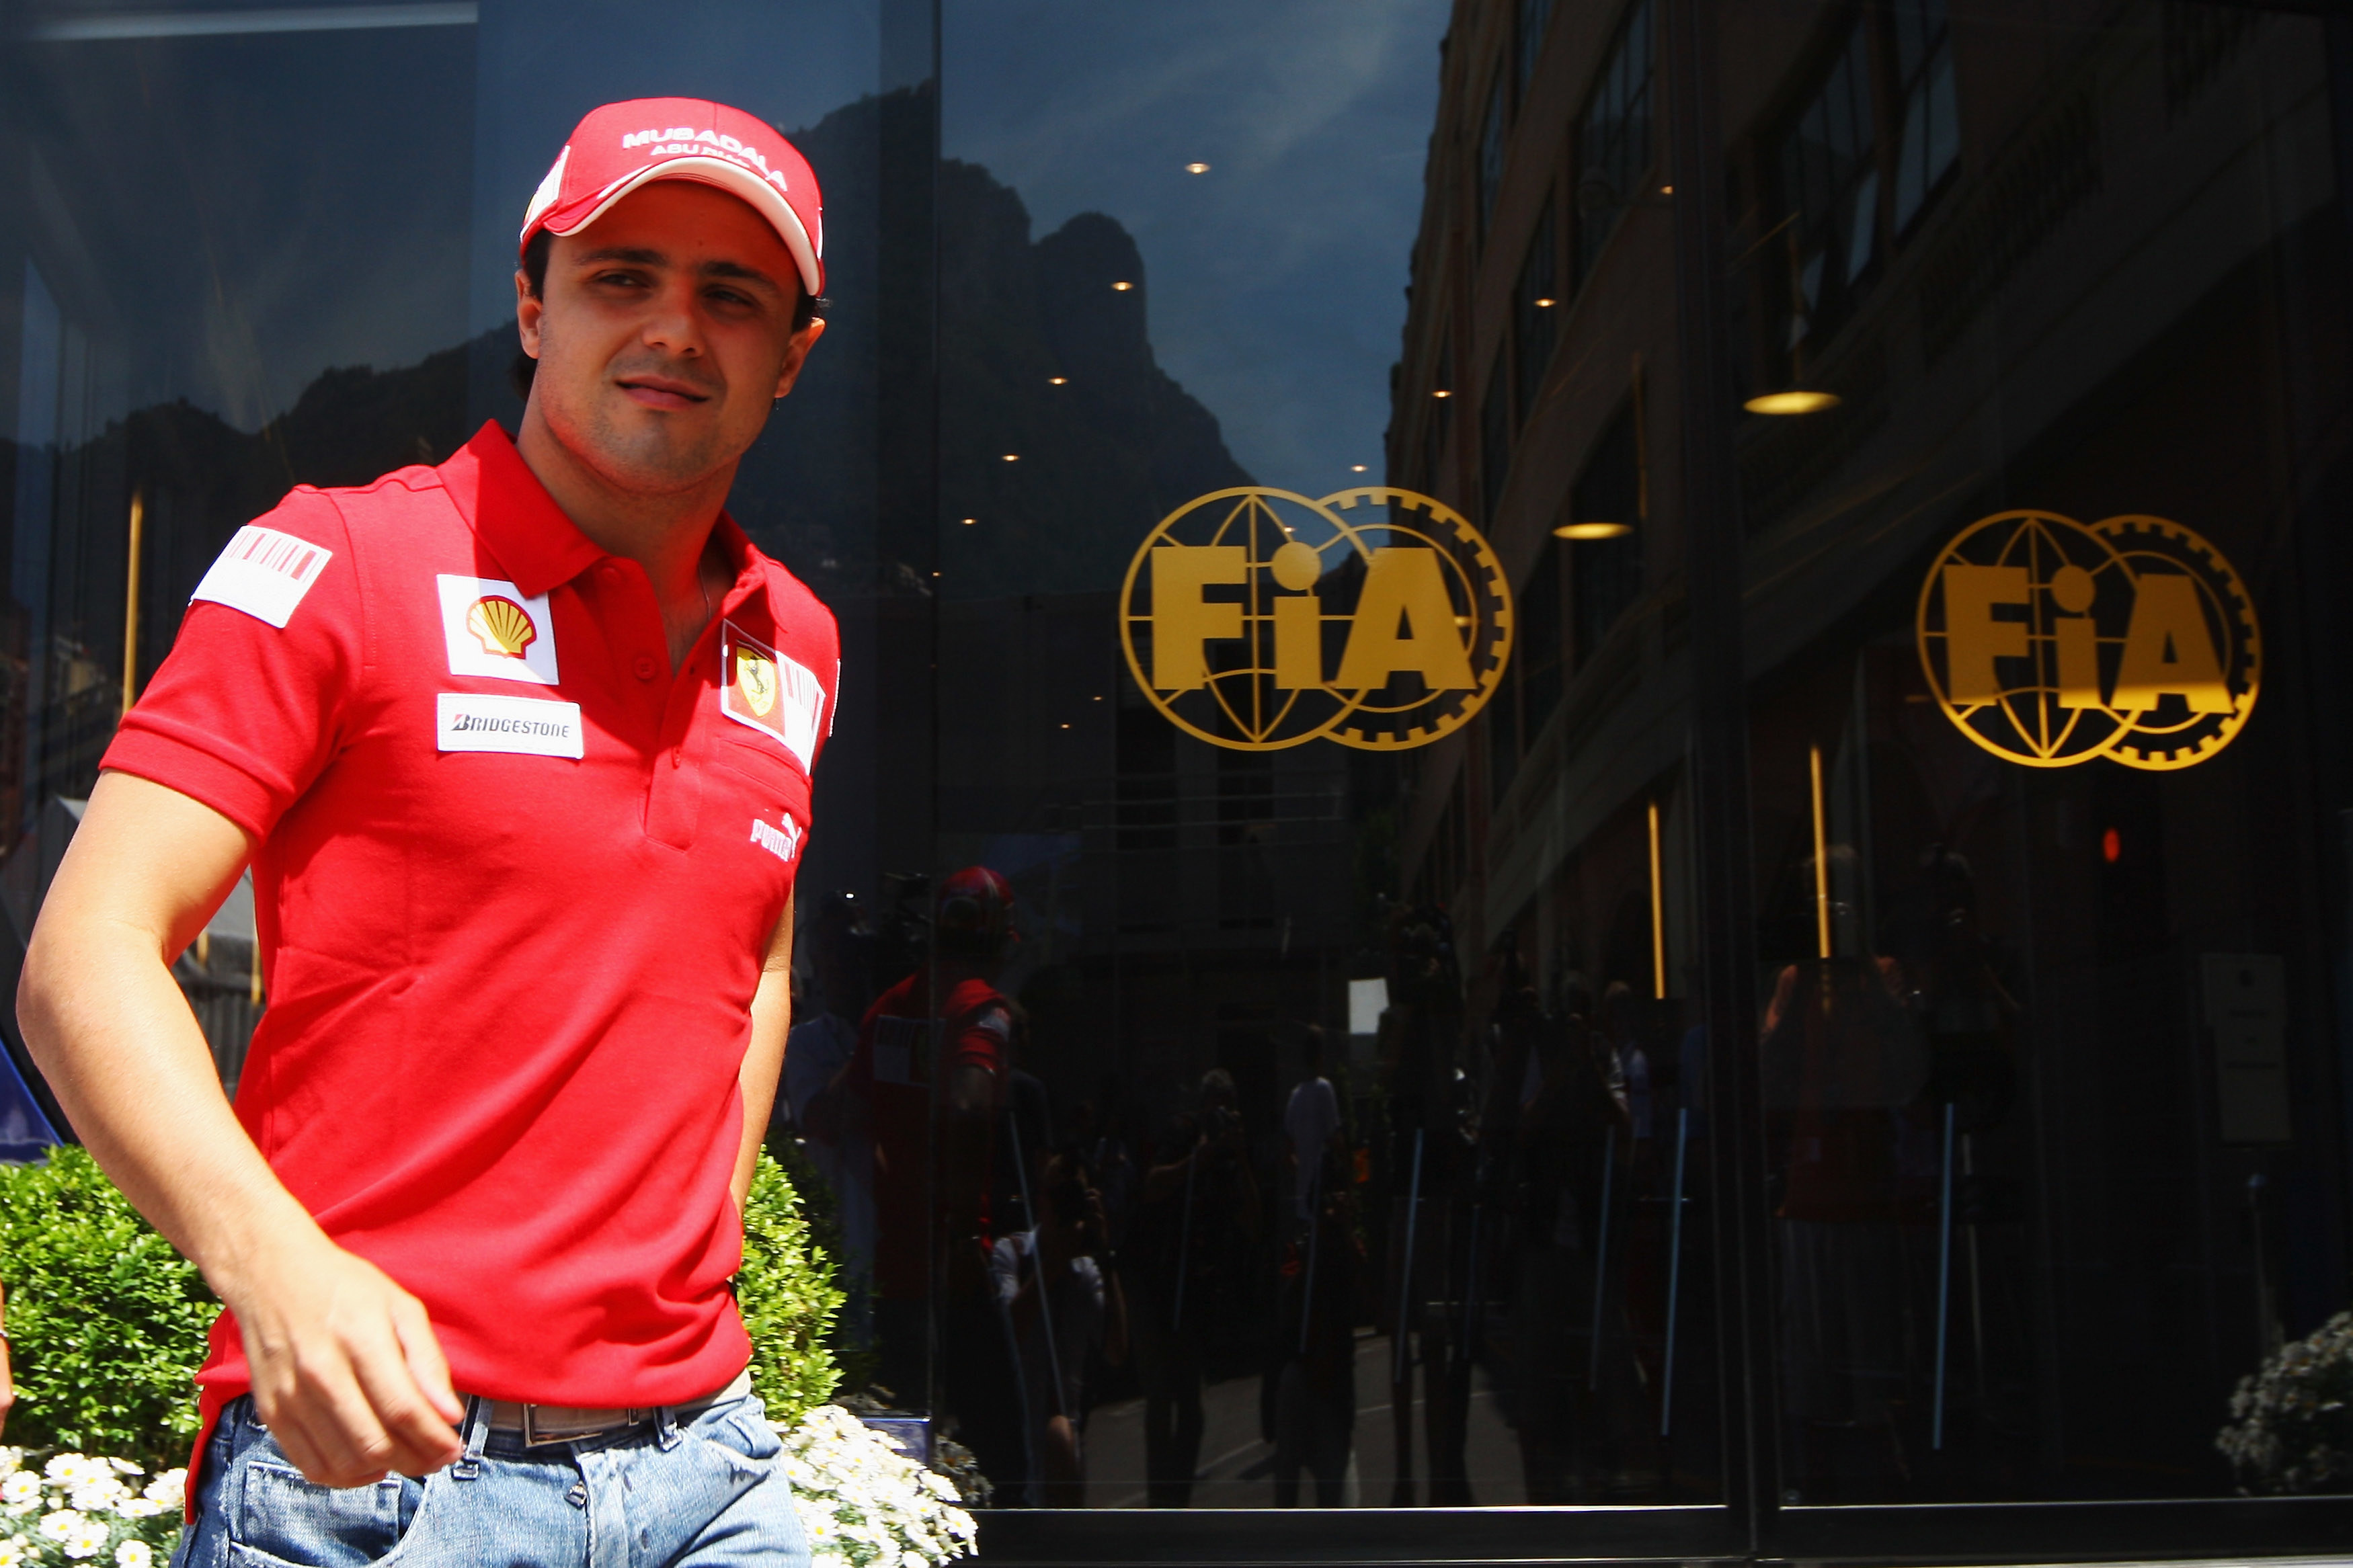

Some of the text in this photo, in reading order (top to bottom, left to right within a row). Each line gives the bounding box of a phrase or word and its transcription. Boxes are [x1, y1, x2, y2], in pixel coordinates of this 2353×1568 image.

[623, 128, 787, 192] MUBADALA
[651, 144, 699, 155] ABU
[451, 714, 569, 737] BRIDGESTONE
